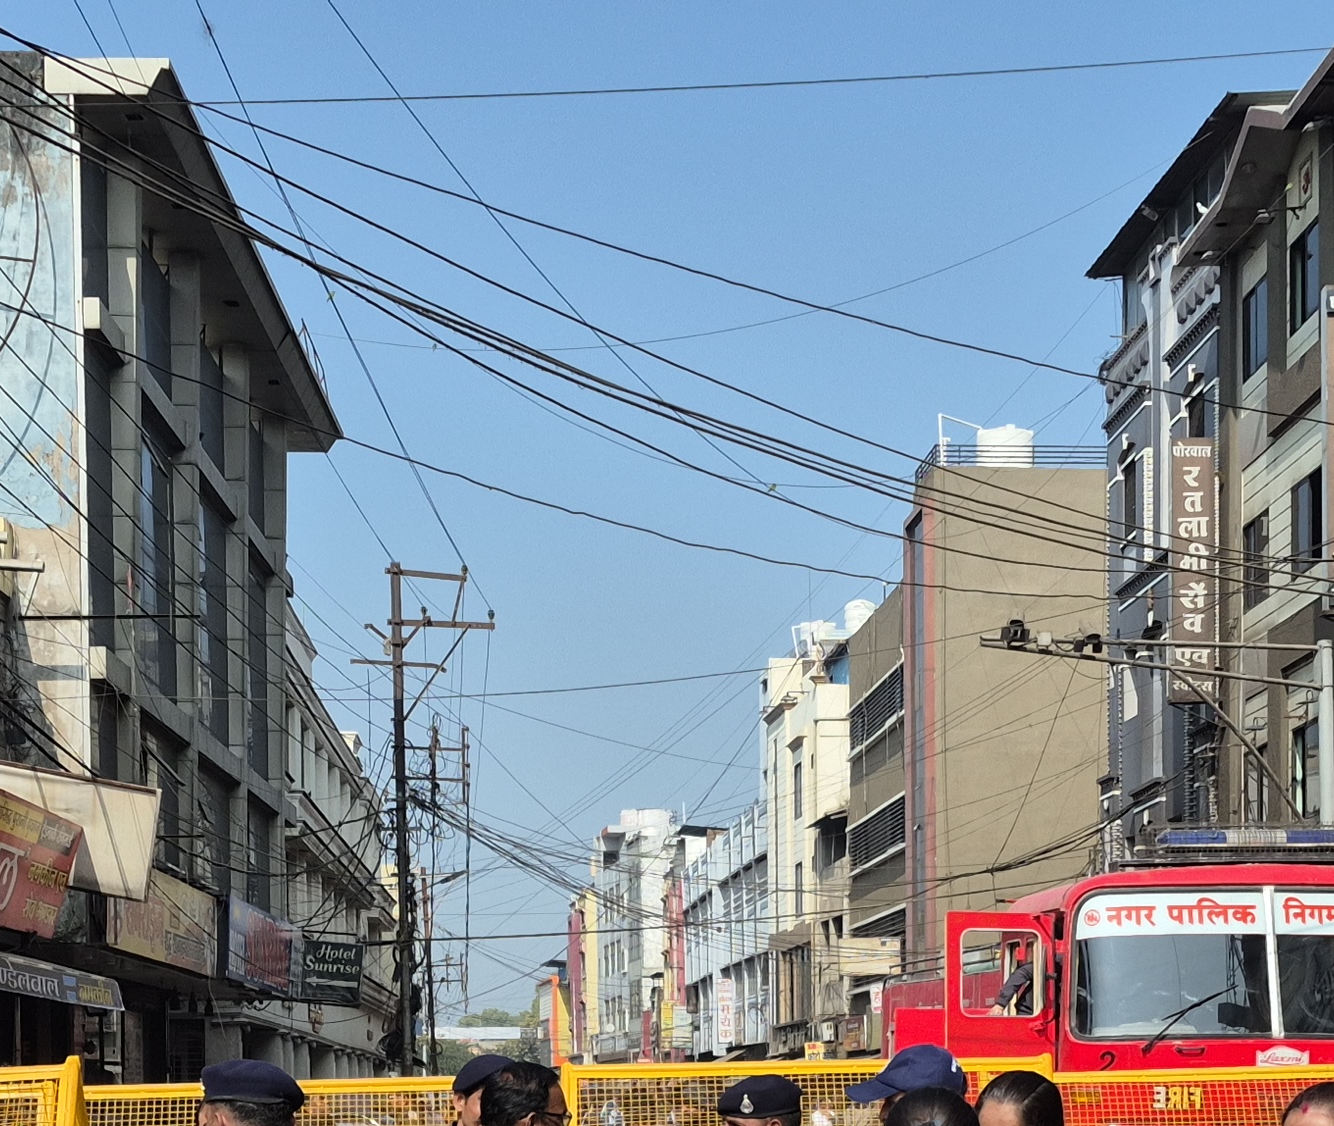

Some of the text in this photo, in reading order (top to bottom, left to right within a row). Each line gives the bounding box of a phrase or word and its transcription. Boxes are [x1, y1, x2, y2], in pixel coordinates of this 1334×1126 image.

[1105, 905, 1157, 927] नगर
[1167, 896, 1257, 926] पालिक
[316, 943, 357, 960] Hotel
[303, 954, 360, 975] Sunrise
